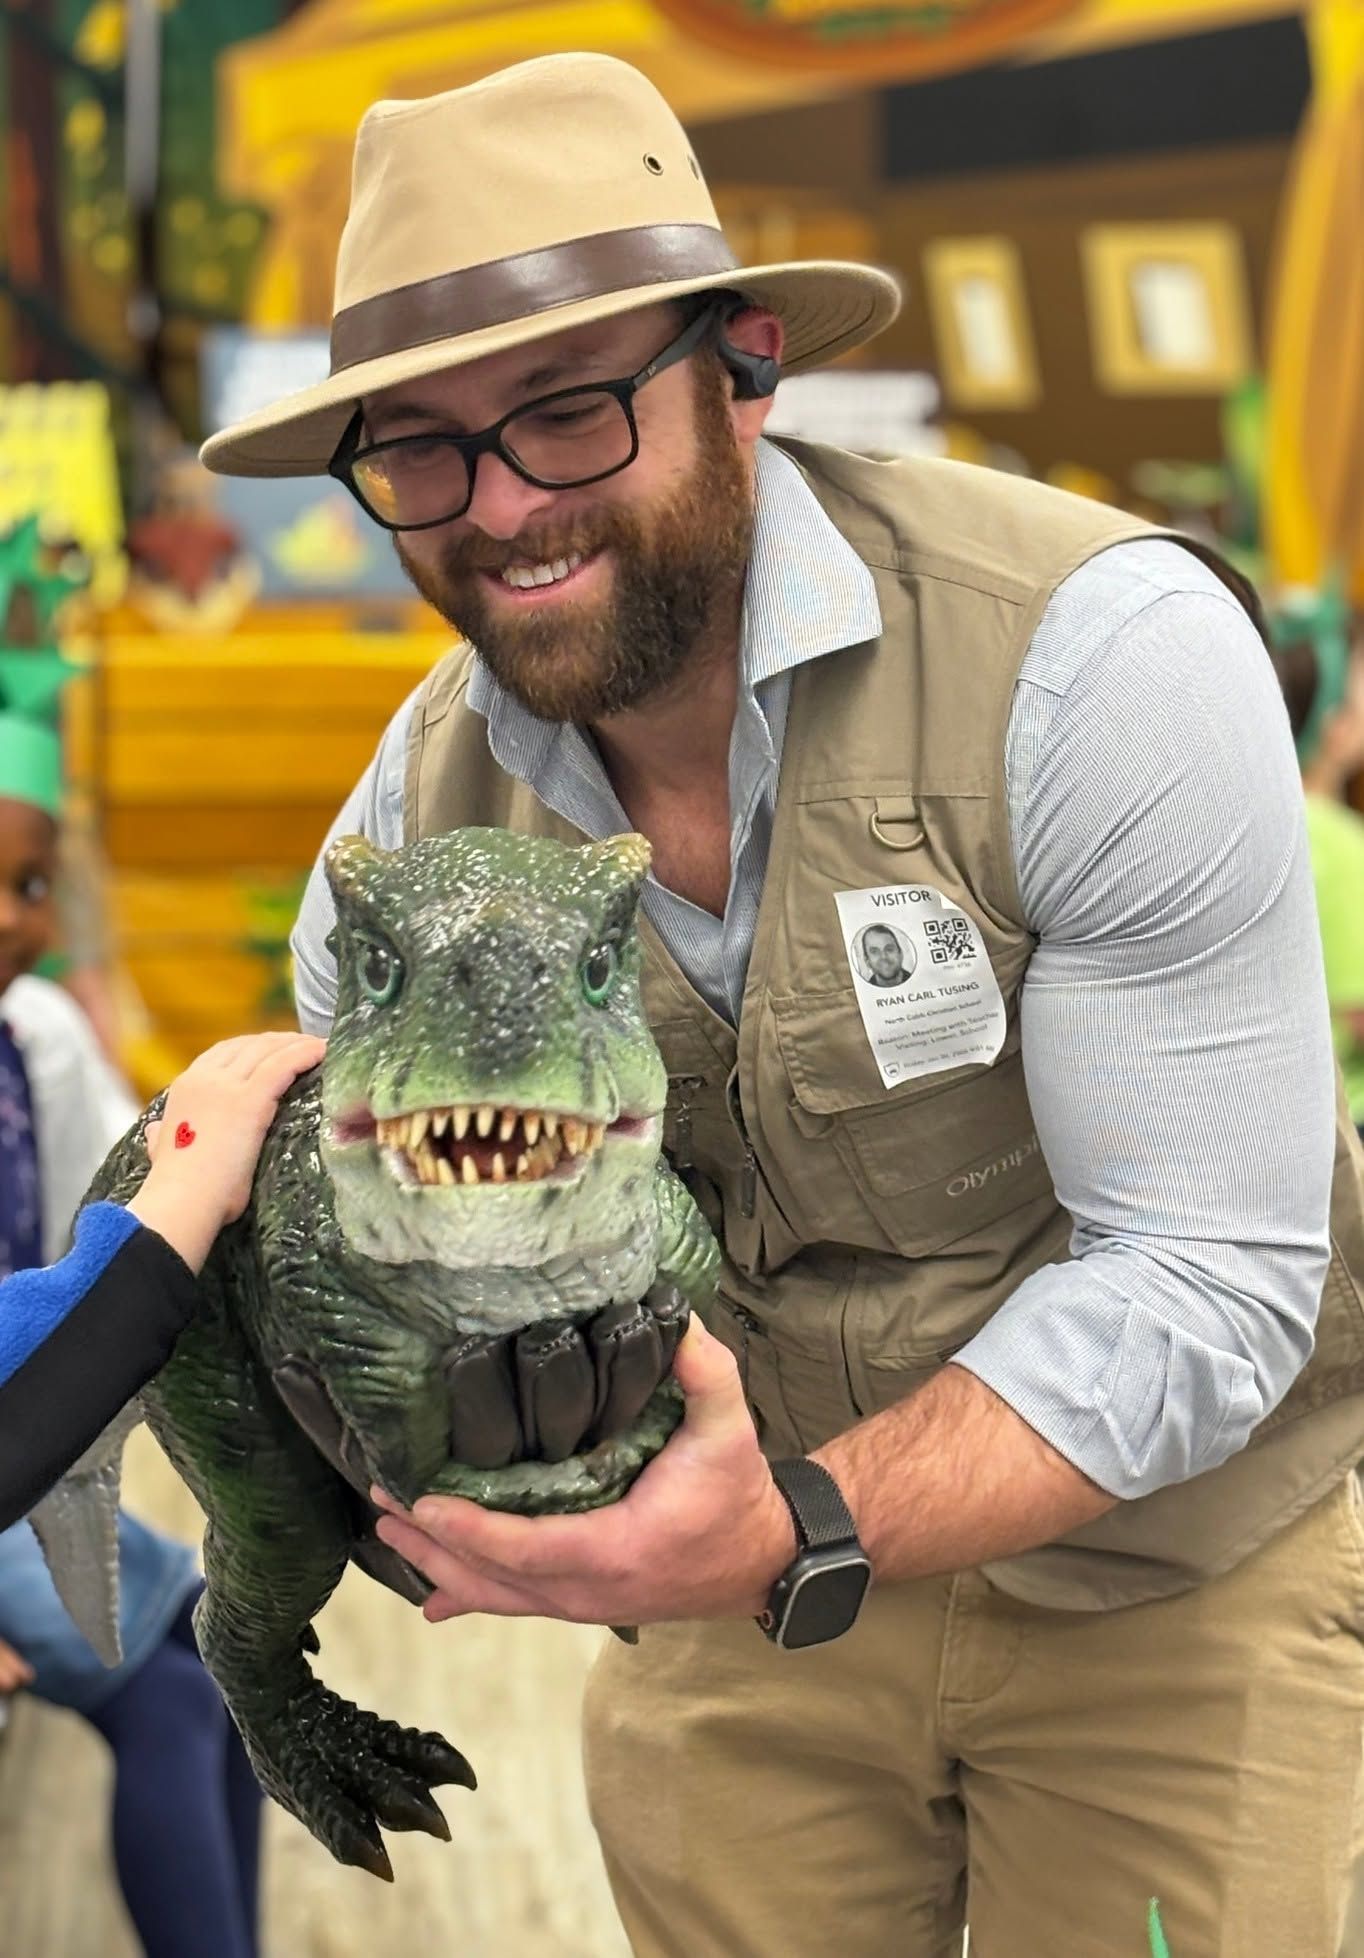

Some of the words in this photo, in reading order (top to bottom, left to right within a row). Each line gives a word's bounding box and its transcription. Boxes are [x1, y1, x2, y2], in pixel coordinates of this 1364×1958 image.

[871, 890, 931, 907] VISITOR
[876, 995, 905, 1008] RYAN
[907, 990, 936, 1002] CARL
[937, 981, 980, 997] TUSING
